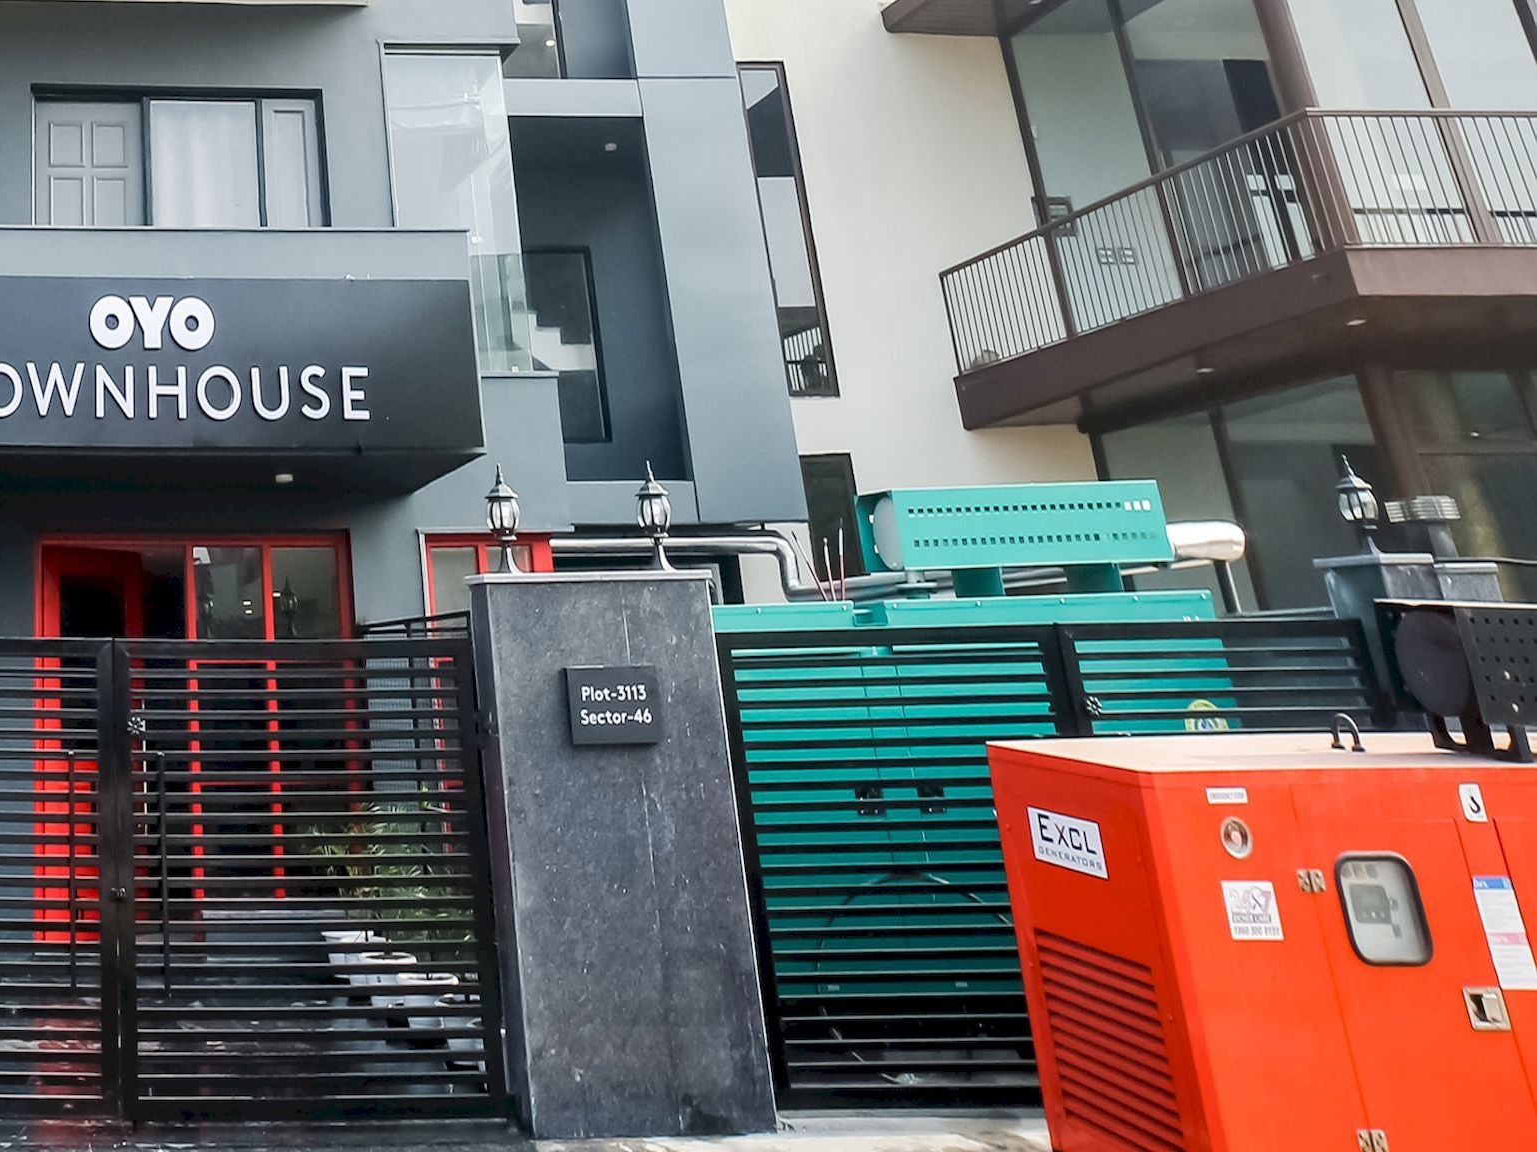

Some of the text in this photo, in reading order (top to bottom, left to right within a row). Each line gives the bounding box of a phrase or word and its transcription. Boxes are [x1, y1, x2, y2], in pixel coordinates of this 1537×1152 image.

[89, 295, 215, 350] OYO
[580, 684, 647, 702] Plot-3113
[579, 708, 653, 725] Sector-46
[1038, 846, 1103, 870] GENERATORS
